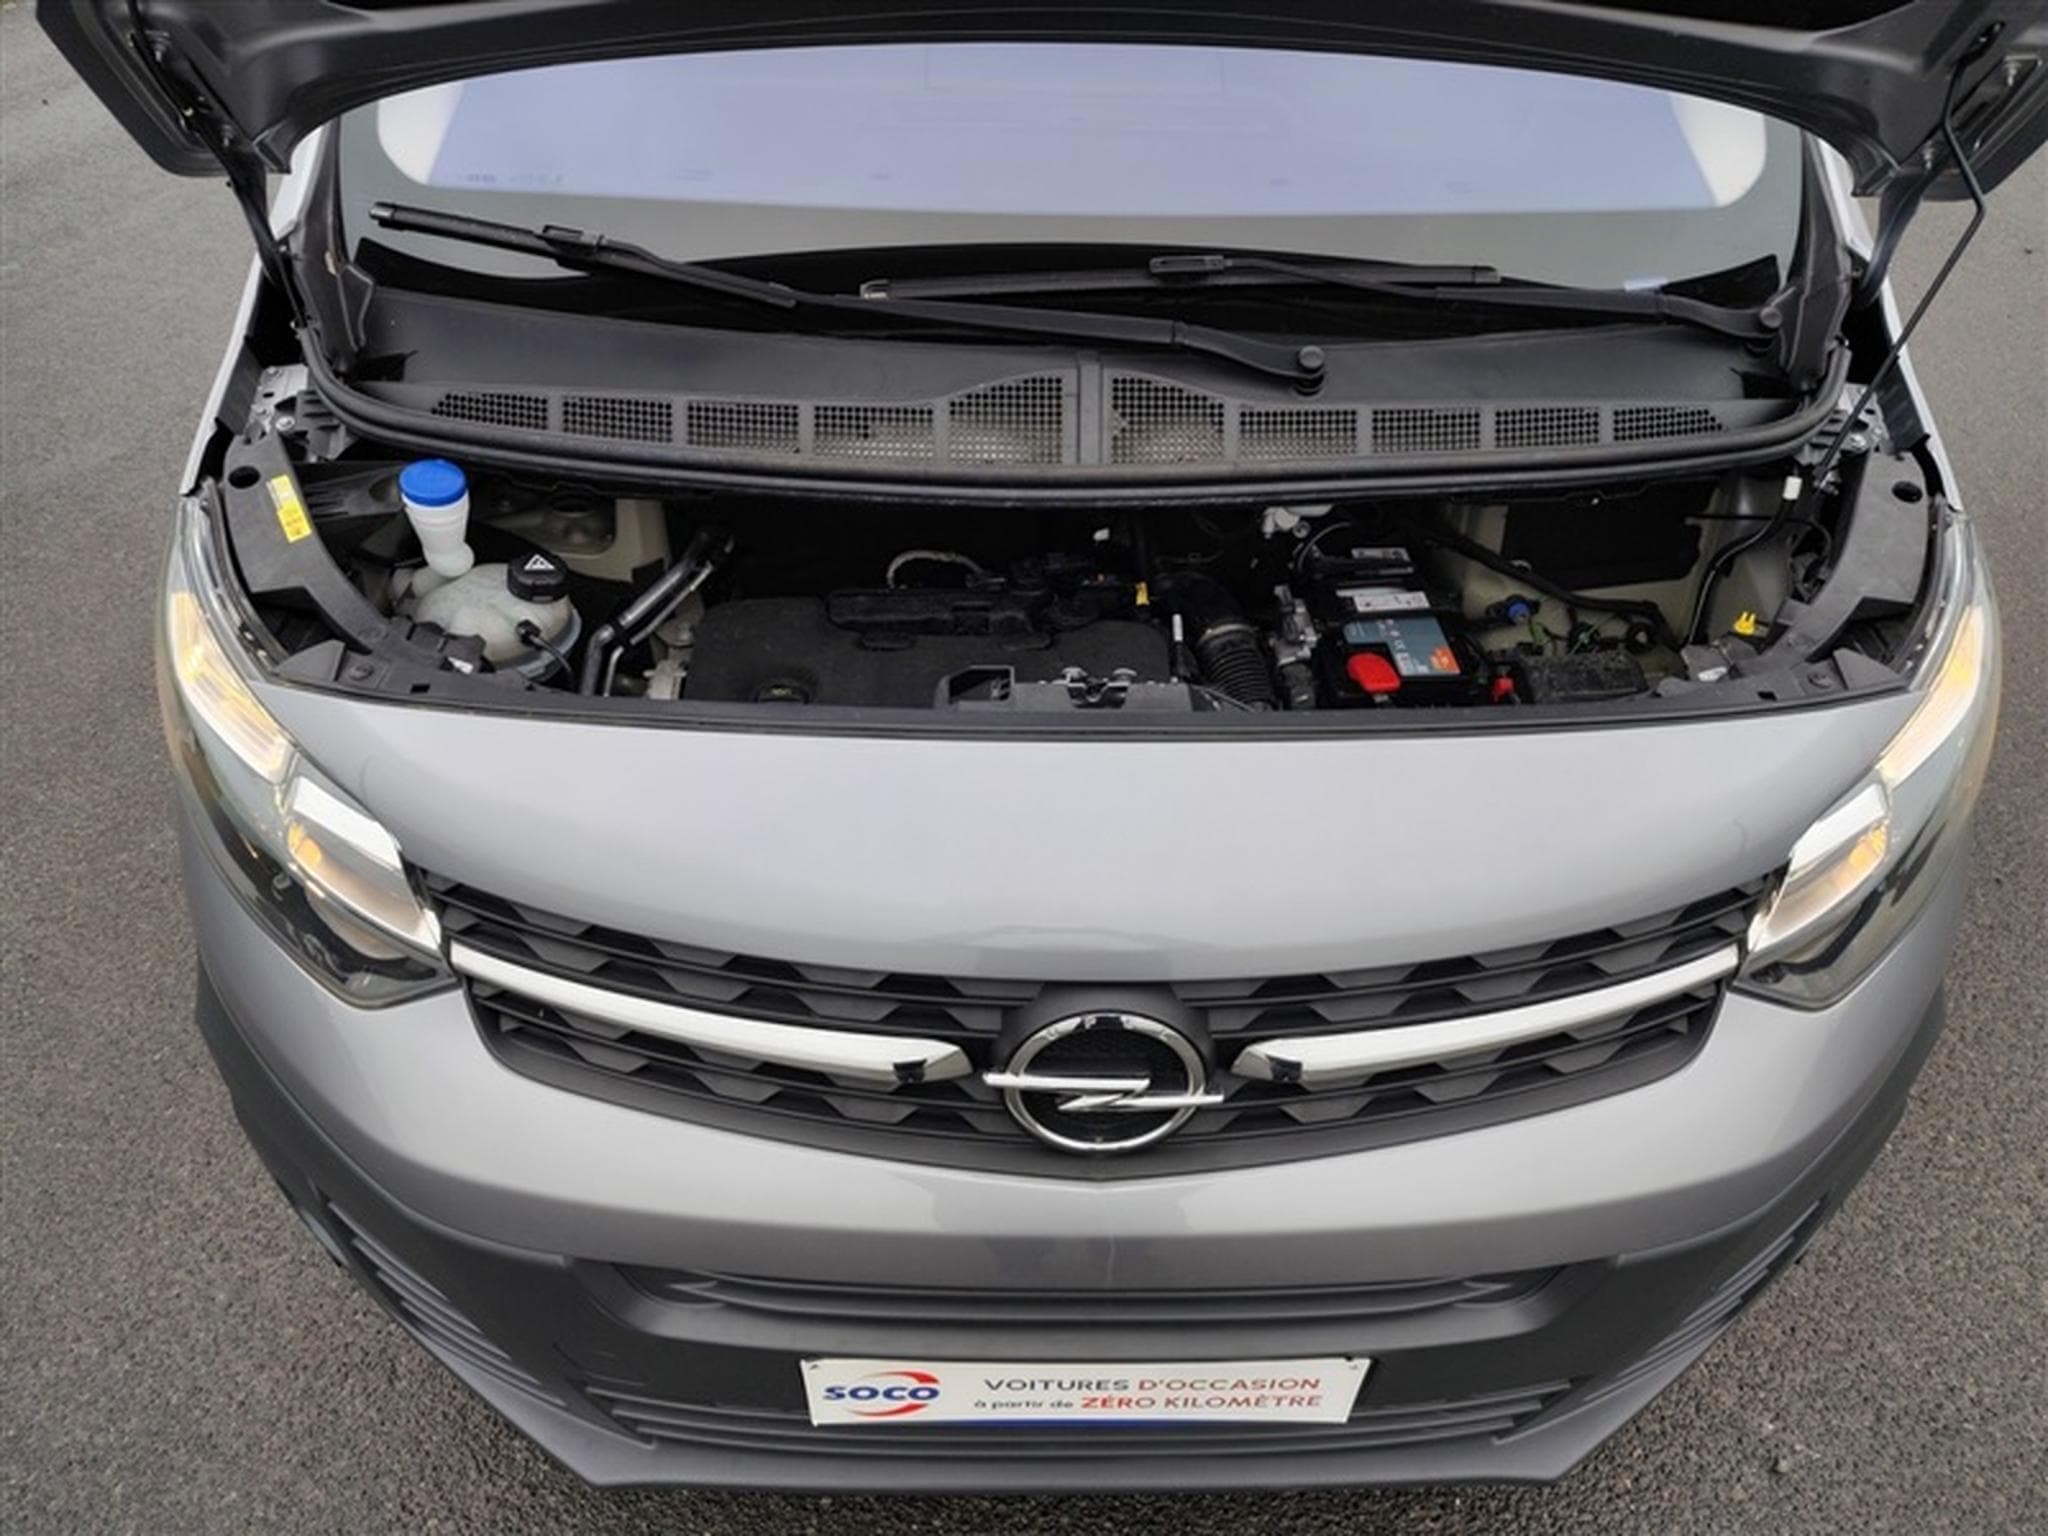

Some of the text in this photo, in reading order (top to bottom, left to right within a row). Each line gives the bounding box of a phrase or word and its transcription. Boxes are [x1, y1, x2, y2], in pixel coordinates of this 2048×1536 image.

[984, 1378, 1321, 1391] VOITURES D'OCCASION
[823, 1386, 940, 1401] SOCO
[991, 1399, 1044, 1410] partir
[1049, 1399, 1074, 1409] de
[1080, 1394, 1156, 1409] ZÉRO
